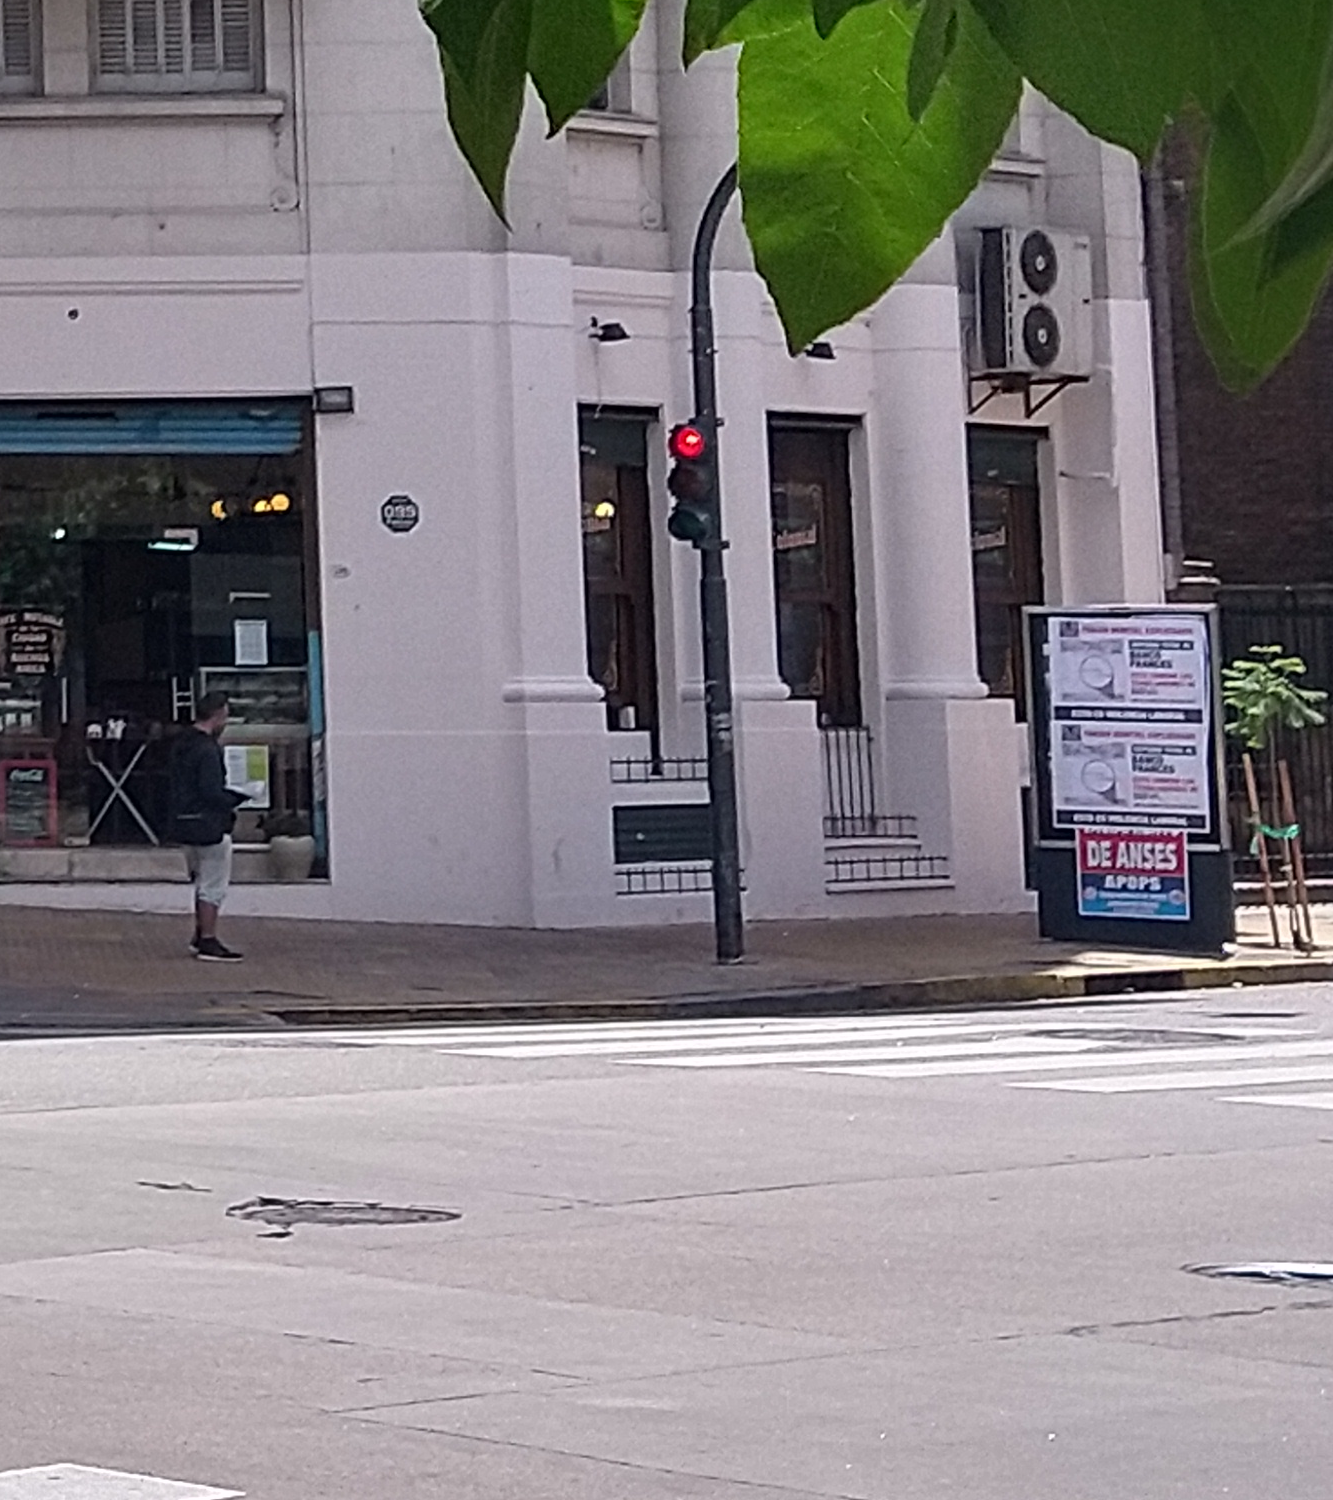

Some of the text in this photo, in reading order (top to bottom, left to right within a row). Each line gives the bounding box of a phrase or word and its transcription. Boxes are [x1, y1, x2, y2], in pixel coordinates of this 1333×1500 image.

[1086, 840, 1178, 871] DE ANSES
[1104, 874, 1162, 891] APOPS
